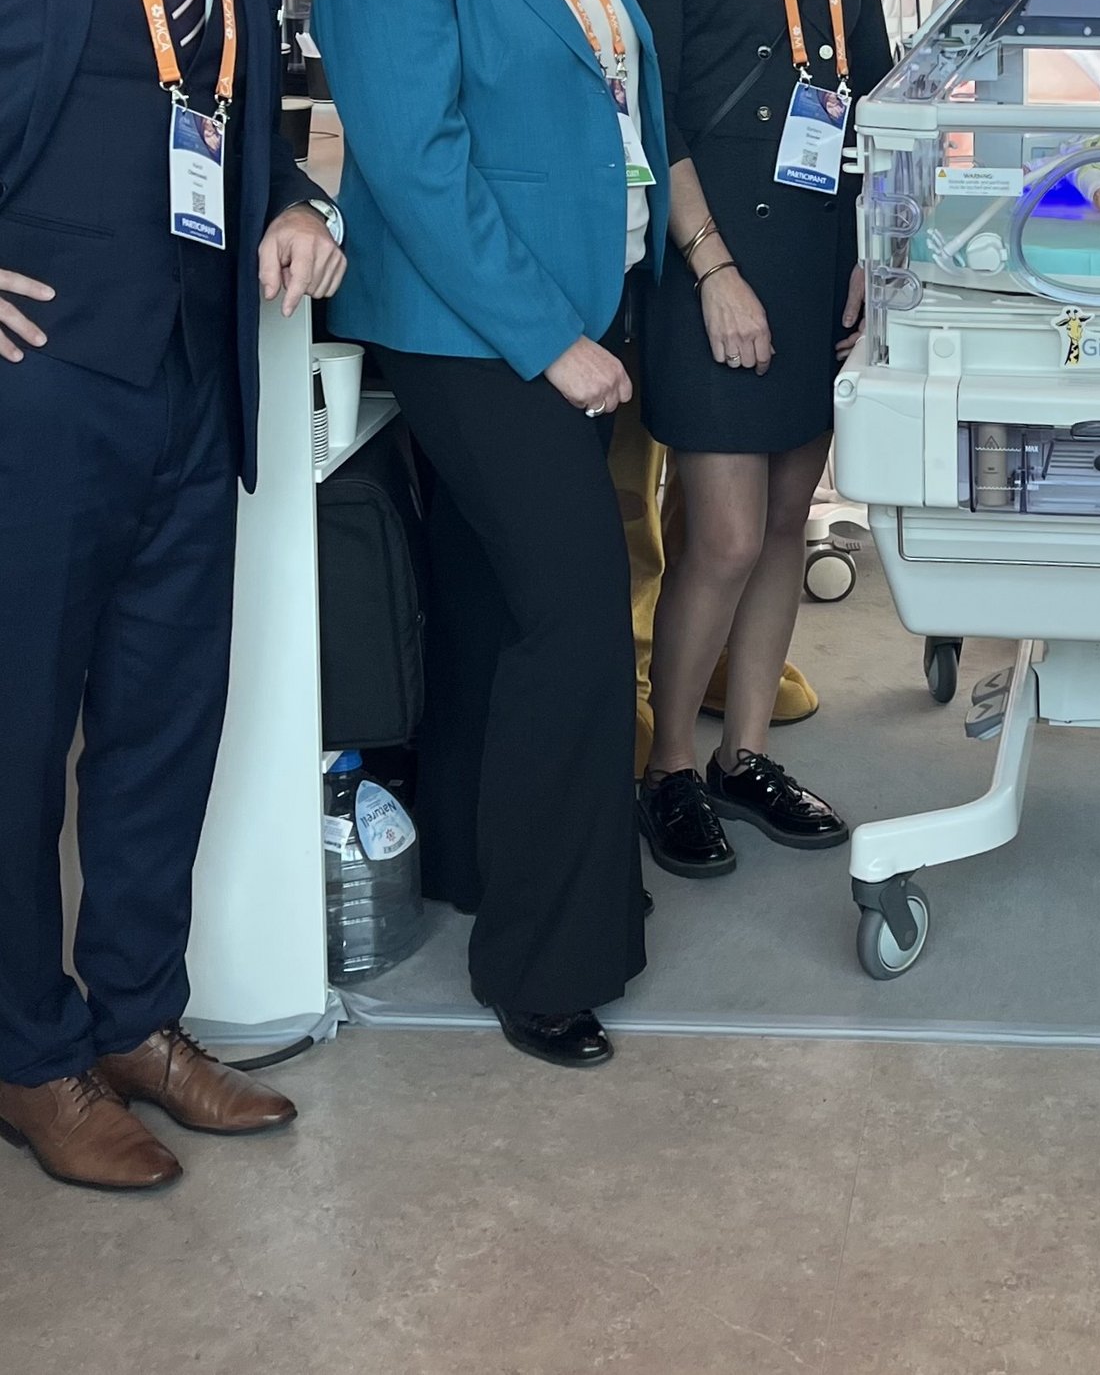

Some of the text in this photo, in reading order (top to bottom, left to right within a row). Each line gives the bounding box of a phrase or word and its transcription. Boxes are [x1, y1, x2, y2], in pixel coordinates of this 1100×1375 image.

[153, 19, 171, 53] MCA
[786, 169, 828, 184] PARTICIPANT
[182, 217, 216, 236] PARTICIPANT
[360, 799, 398, 829] Naturell
